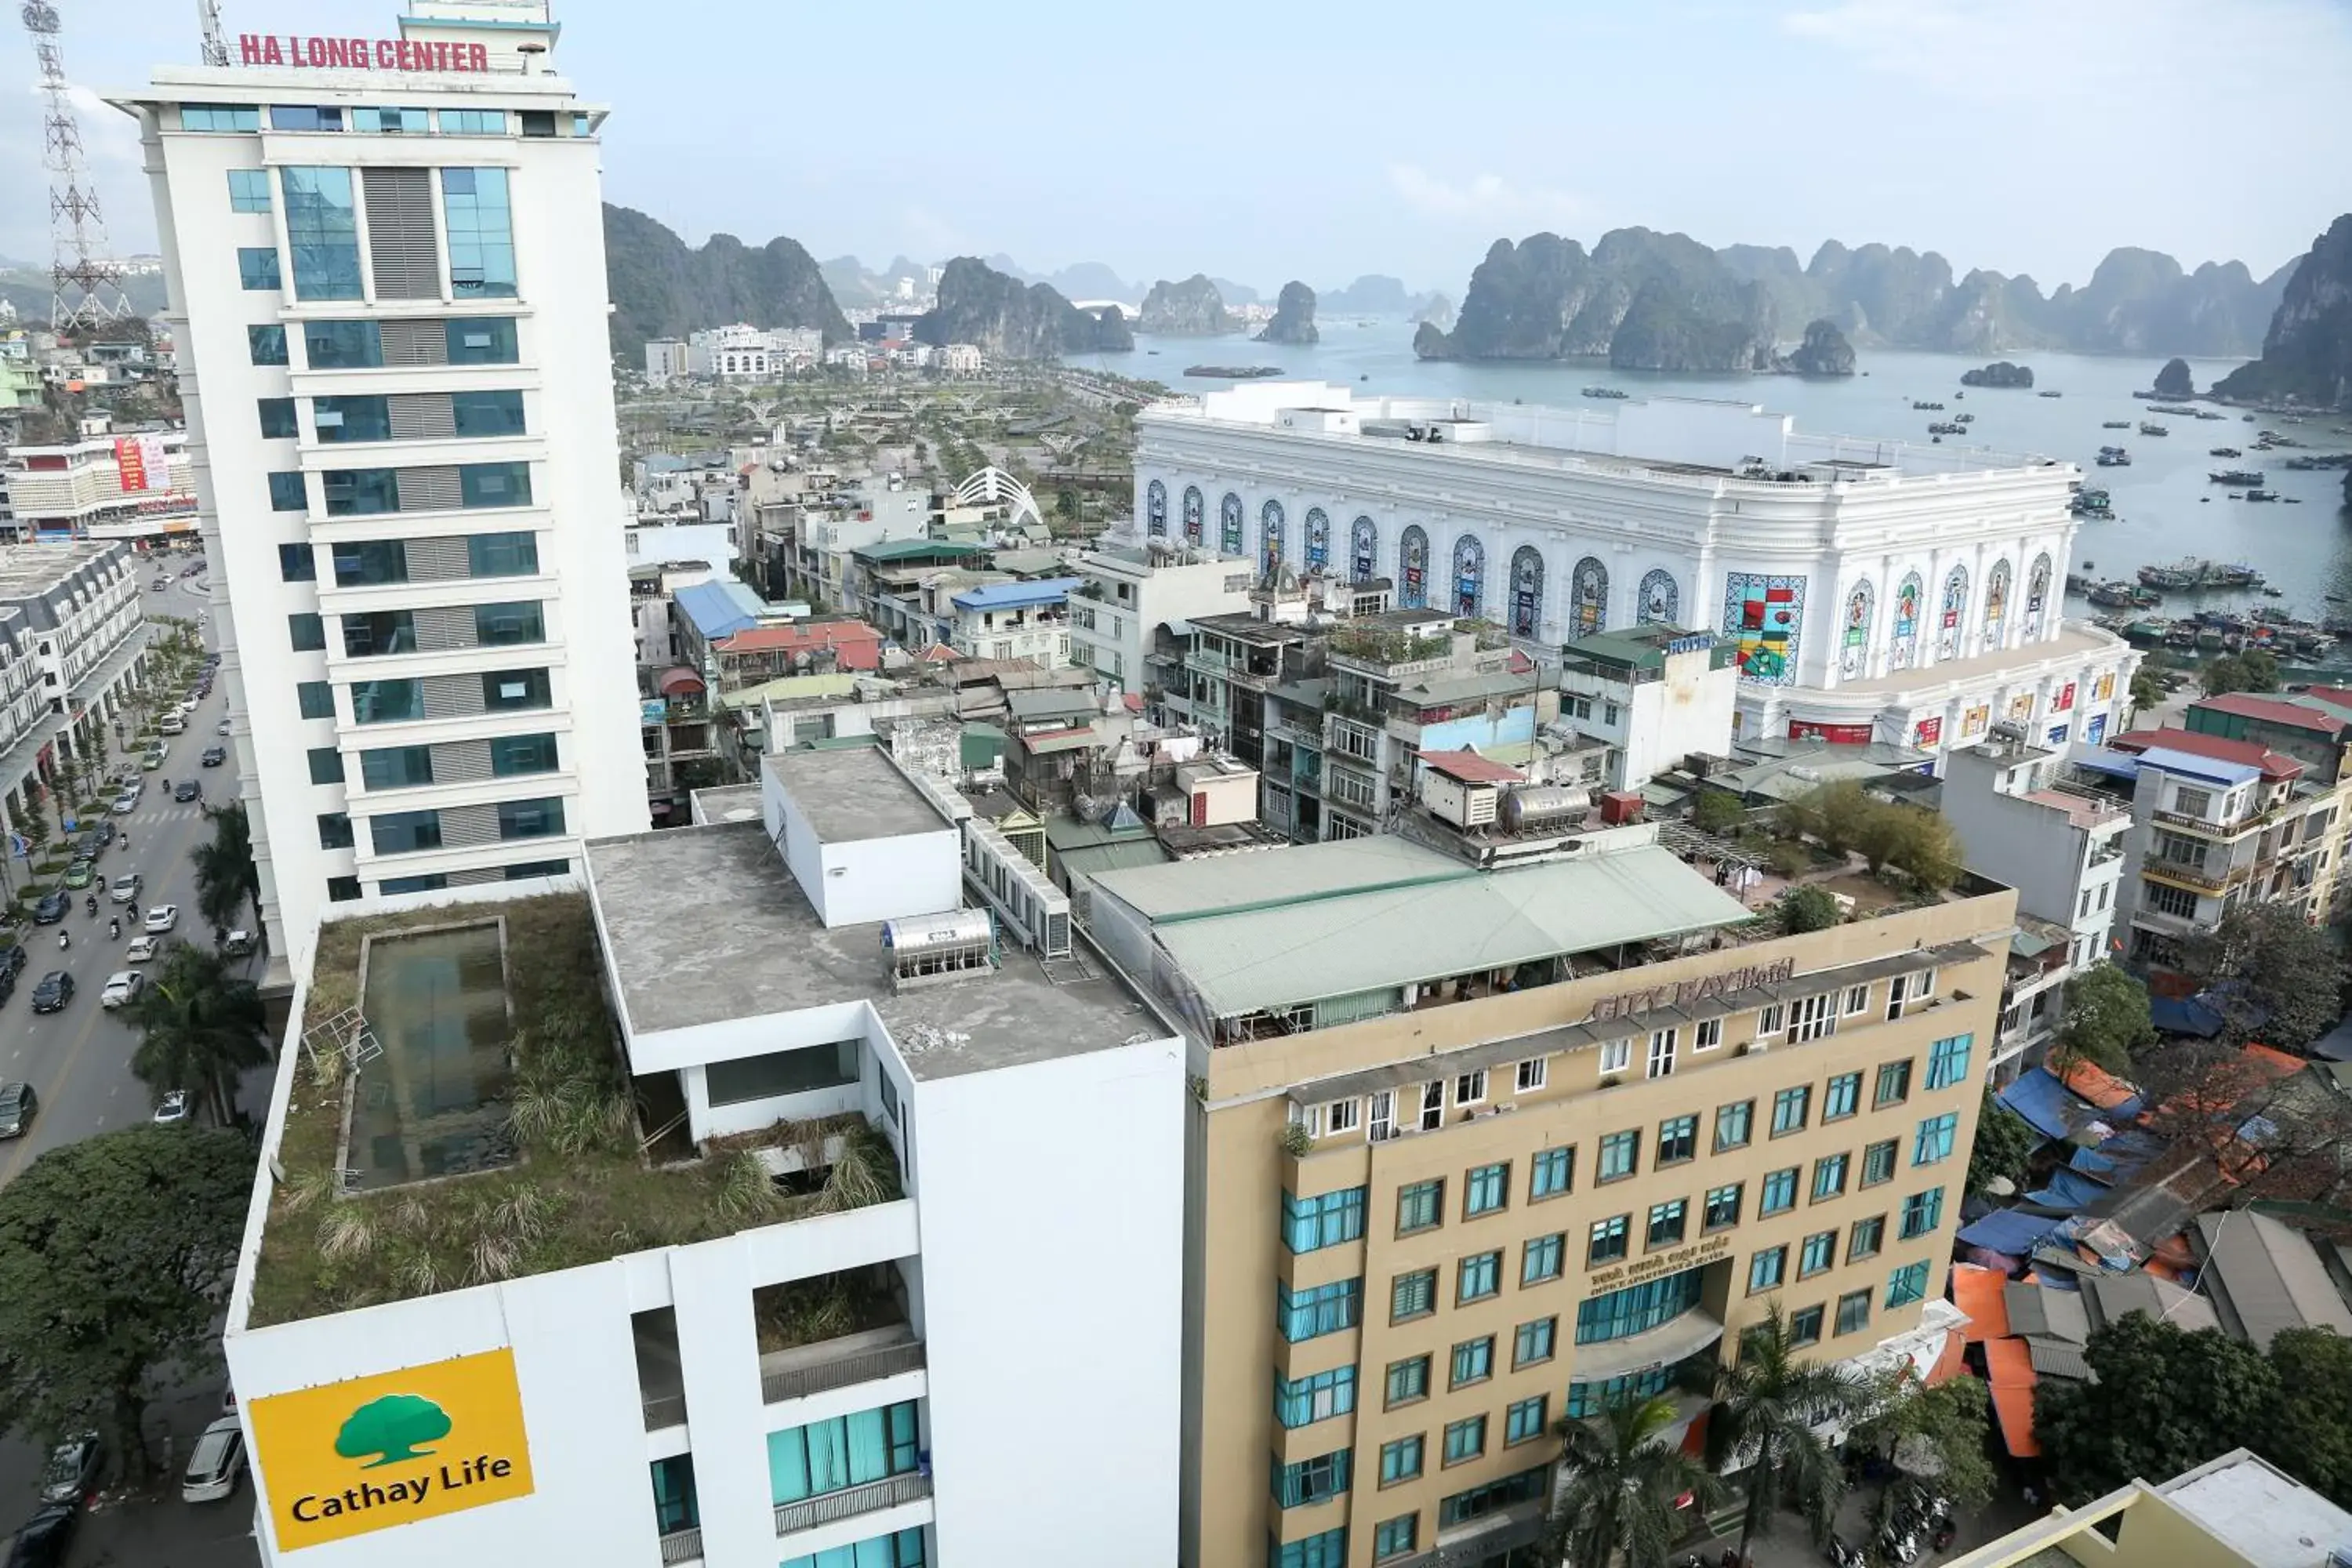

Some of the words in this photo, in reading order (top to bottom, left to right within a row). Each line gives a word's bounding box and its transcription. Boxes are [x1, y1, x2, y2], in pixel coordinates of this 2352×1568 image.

[240, 34, 284, 66] HA
[289, 37, 369, 69] LONG
[376, 40, 488, 72] CENTER
[292, 1476, 430, 1522] Cathay
[441, 1455, 511, 1490] Life
